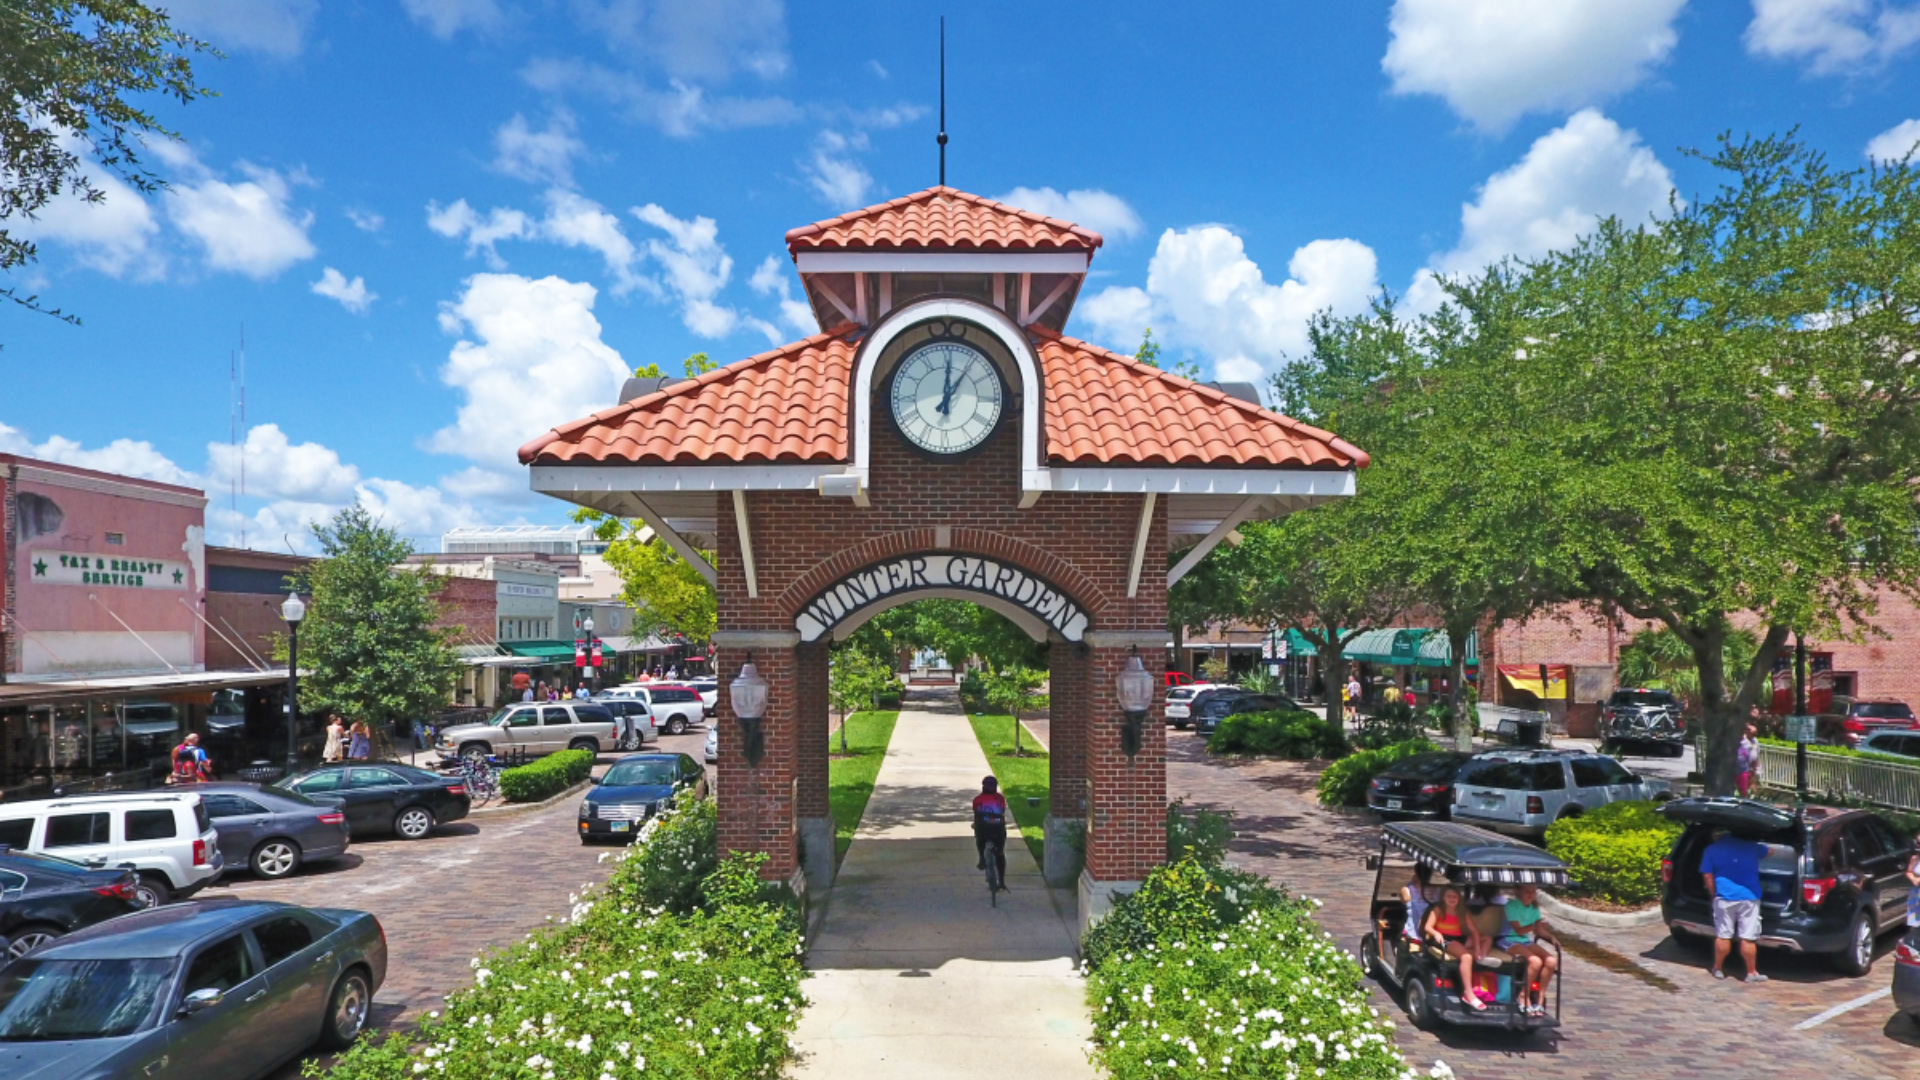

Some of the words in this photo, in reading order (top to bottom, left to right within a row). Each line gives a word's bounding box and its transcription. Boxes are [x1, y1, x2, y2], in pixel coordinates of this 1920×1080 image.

[60, 555, 89, 568] TAX
[96, 558, 105, 570] &
[111, 559, 163, 574] REALTY
[82, 572, 143, 587] SERVICE
[808, 556, 932, 630] WINTER
[945, 556, 1079, 633] GARDEN
